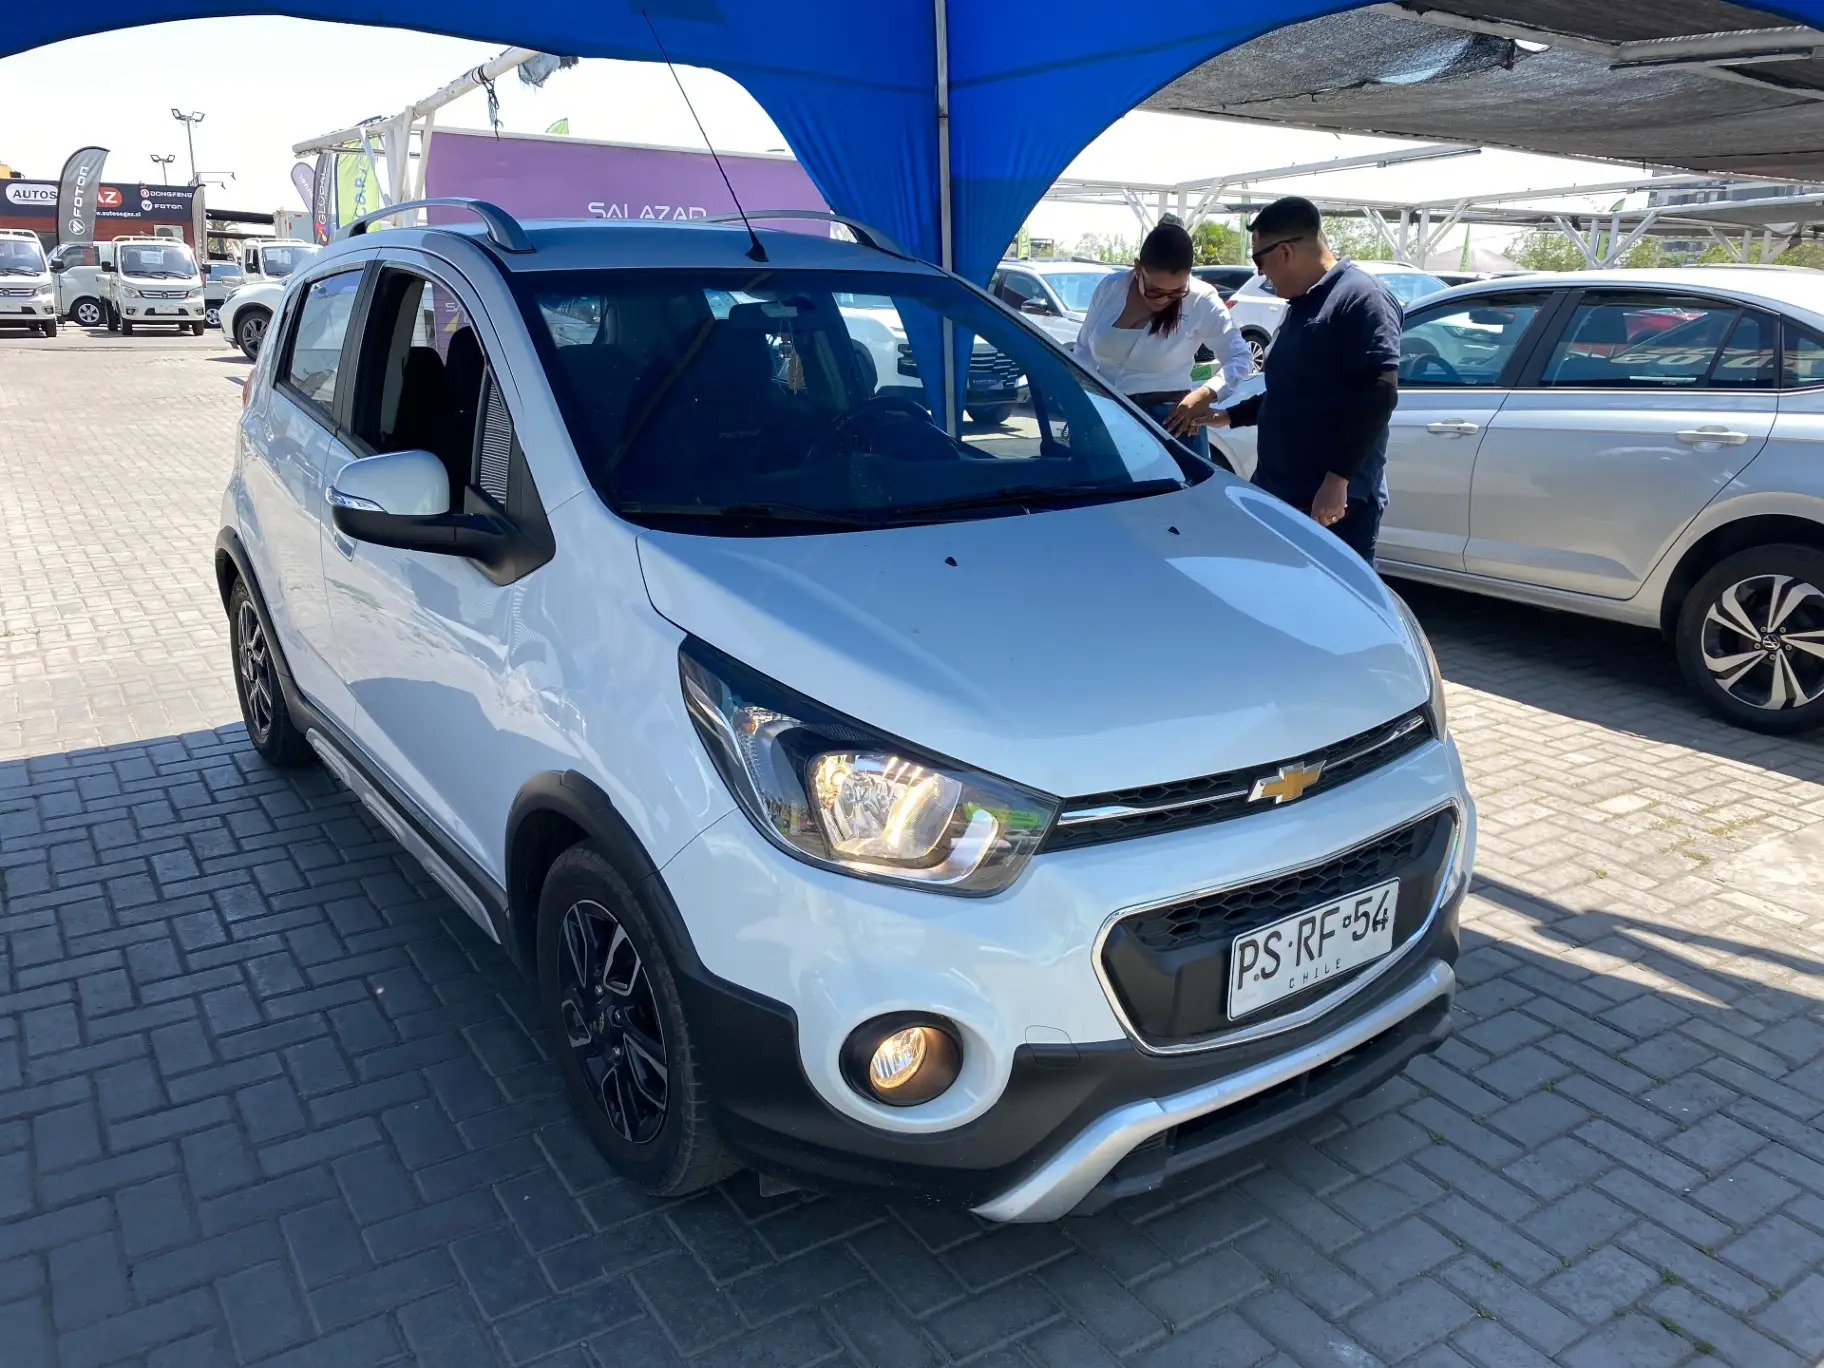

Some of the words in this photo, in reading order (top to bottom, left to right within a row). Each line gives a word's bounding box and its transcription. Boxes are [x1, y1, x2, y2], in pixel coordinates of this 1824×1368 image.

[13, 189, 57, 199] AUTOS
[72, 164, 90, 217] FOTON
[150, 190, 193, 198] DONGFENG
[1289, 958, 1342, 989] CHILE
